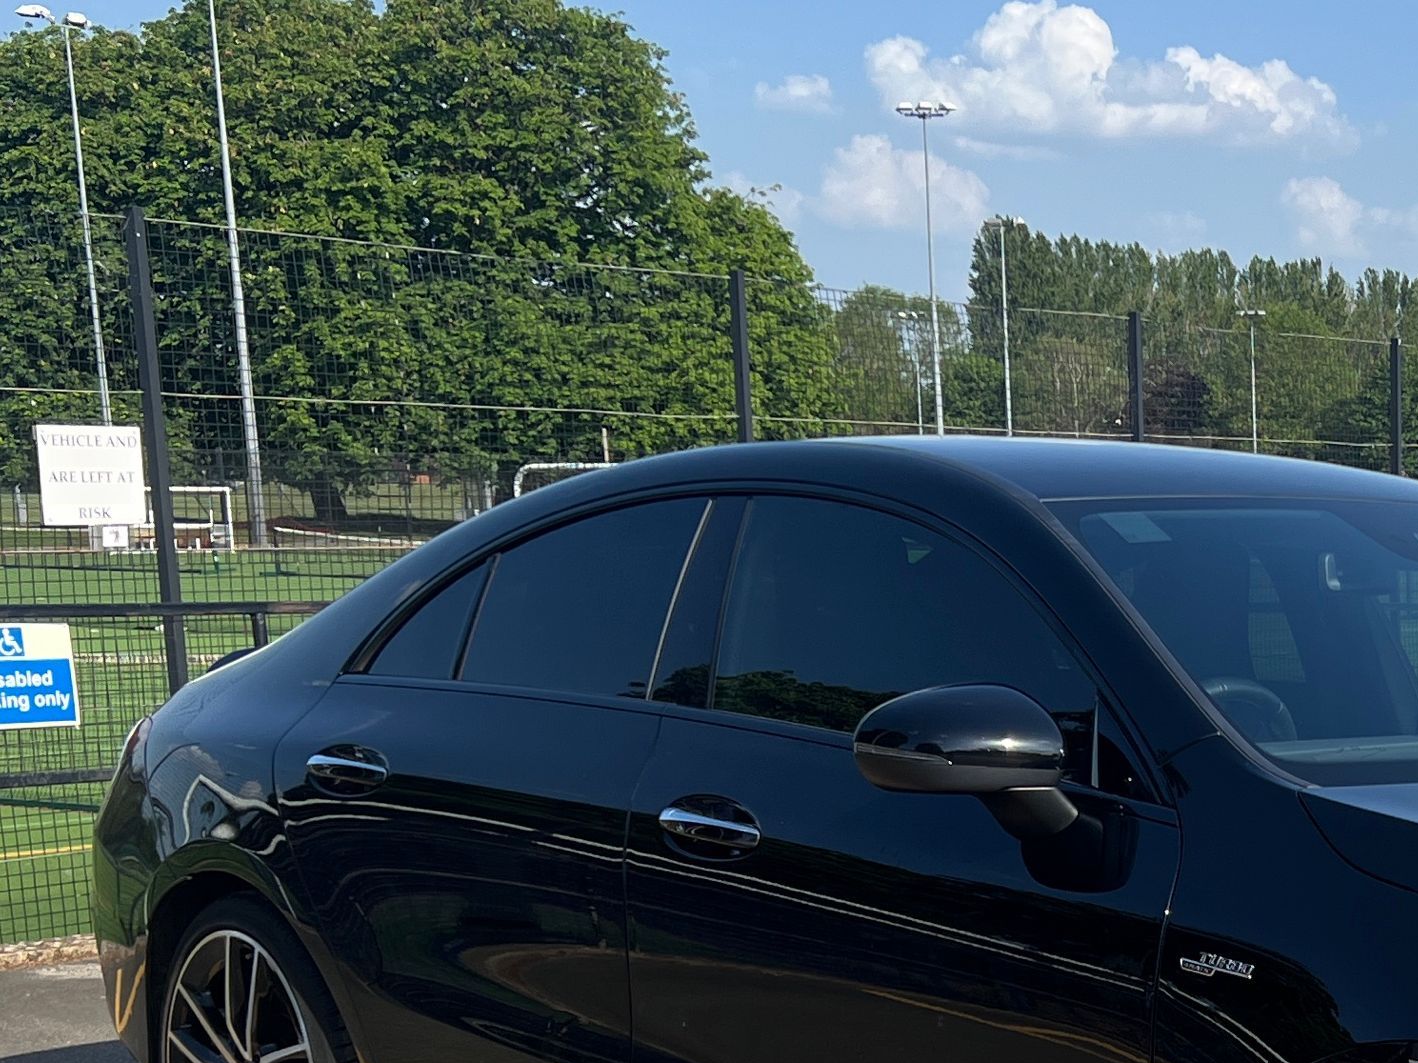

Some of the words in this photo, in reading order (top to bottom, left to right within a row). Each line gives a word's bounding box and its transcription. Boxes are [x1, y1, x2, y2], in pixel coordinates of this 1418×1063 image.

[40, 433, 101, 447] VEHICLE
[106, 436, 137, 448] AND
[49, 471, 77, 483] ARE
[82, 471, 112, 484] LEFT
[117, 471, 135, 483] AT
[79, 507, 112, 518] RISK
[0, 692, 30, 712] ing
[34, 690, 70, 710] only
